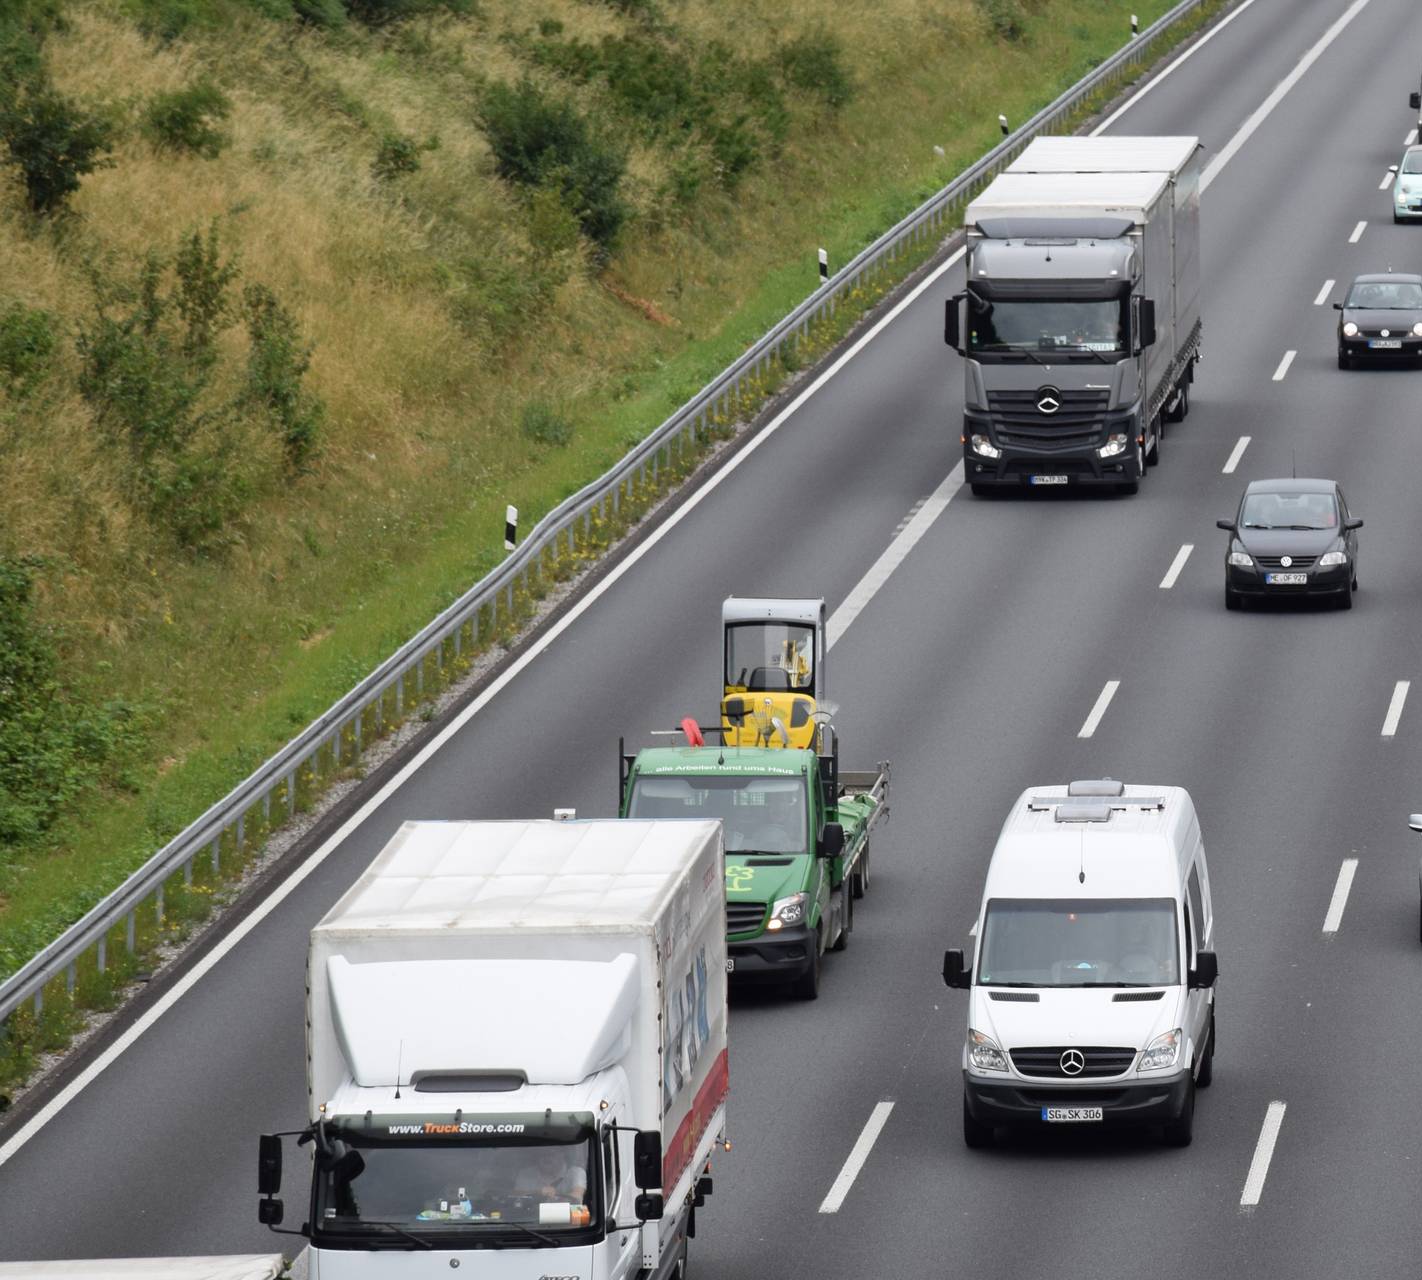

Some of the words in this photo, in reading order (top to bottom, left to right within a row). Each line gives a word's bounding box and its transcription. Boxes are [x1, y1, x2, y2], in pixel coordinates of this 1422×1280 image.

[1048, 1110, 1062, 1119] SG
[1068, 1110, 1081, 1119] SK
[1083, 1110, 1101, 1119] 306
[388, 1122, 525, 1134] www.TruckStore.com
